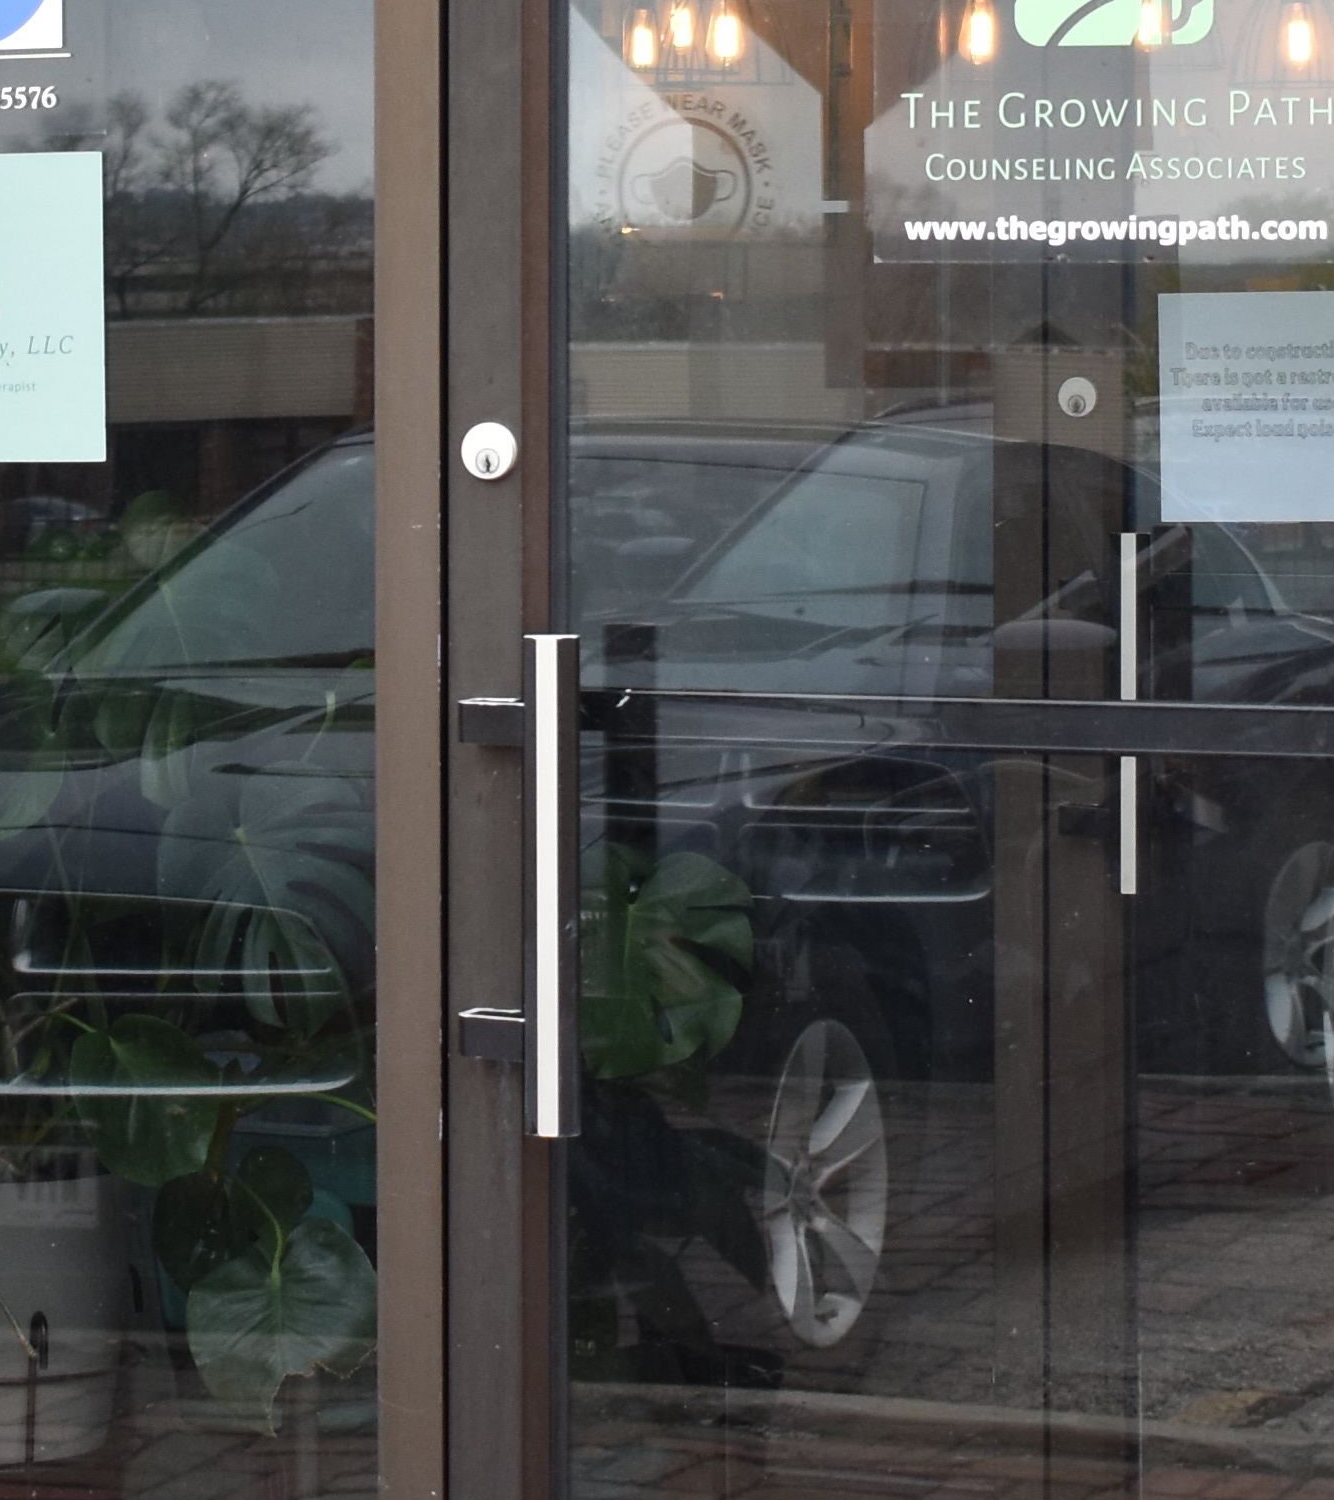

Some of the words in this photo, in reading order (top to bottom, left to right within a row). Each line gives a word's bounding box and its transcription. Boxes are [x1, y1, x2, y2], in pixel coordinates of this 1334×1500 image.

[901, 92, 982, 129] THE
[998, 91, 1207, 129] GROWING
[1228, 90, 1334, 127] PATH
[924, 153, 1117, 182] COUNSELING
[1125, 152, 1307, 181] ASSOCIATES
[904, 212, 1328, 247] www.thegrowingpath.com
[27, 335, 74, 355] LLC
[1185, 342, 1219, 360] Due
[1223, 342, 1242, 360] to
[1170, 368, 1221, 388] There
[1224, 368, 1239, 386] is
[1242, 369, 1273, 387] not
[1276, 372, 1287, 386] a
[1201, 393, 1278, 412] available
[1281, 393, 1309, 411] for
[1192, 420, 1252, 442] Expect
[1255, 419, 1294, 438] loud
